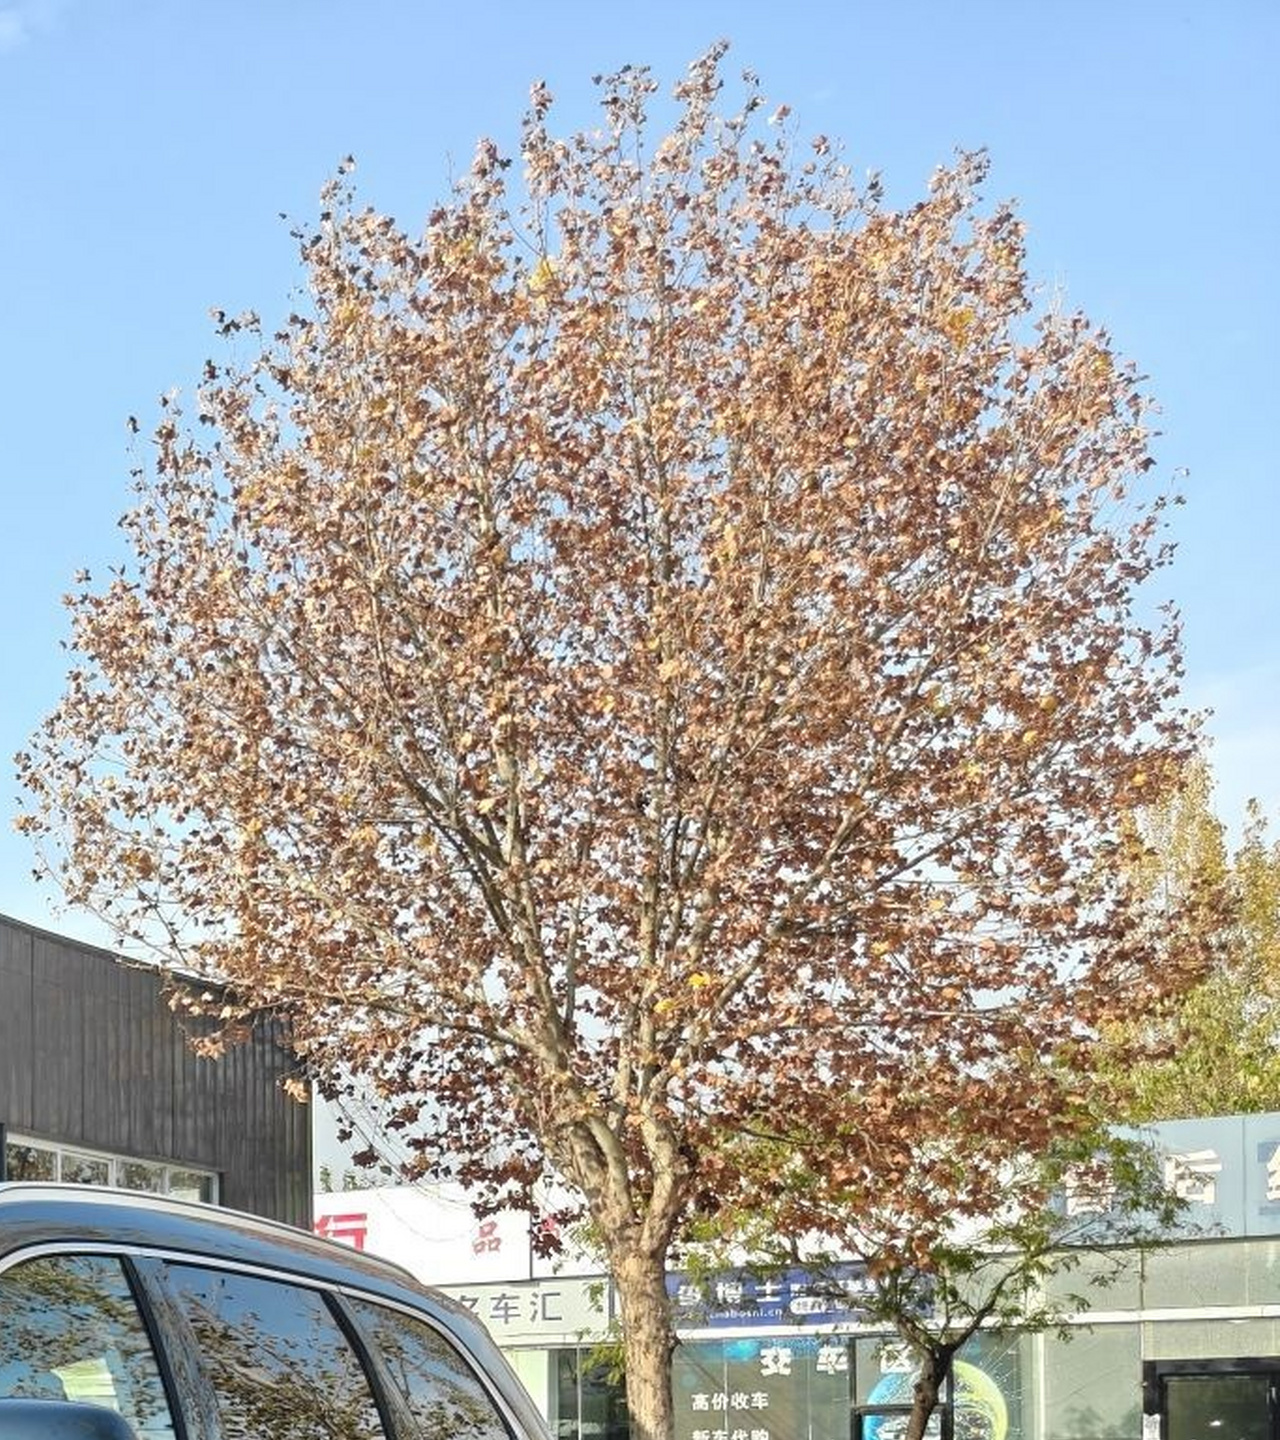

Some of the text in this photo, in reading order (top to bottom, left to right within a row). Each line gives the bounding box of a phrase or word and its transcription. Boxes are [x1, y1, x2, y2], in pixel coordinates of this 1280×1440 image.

[471, 1220, 503, 1255] 品
[759, 1344, 914, 1377] 交车区
[691, 1392, 770, 1411] 高价收车
